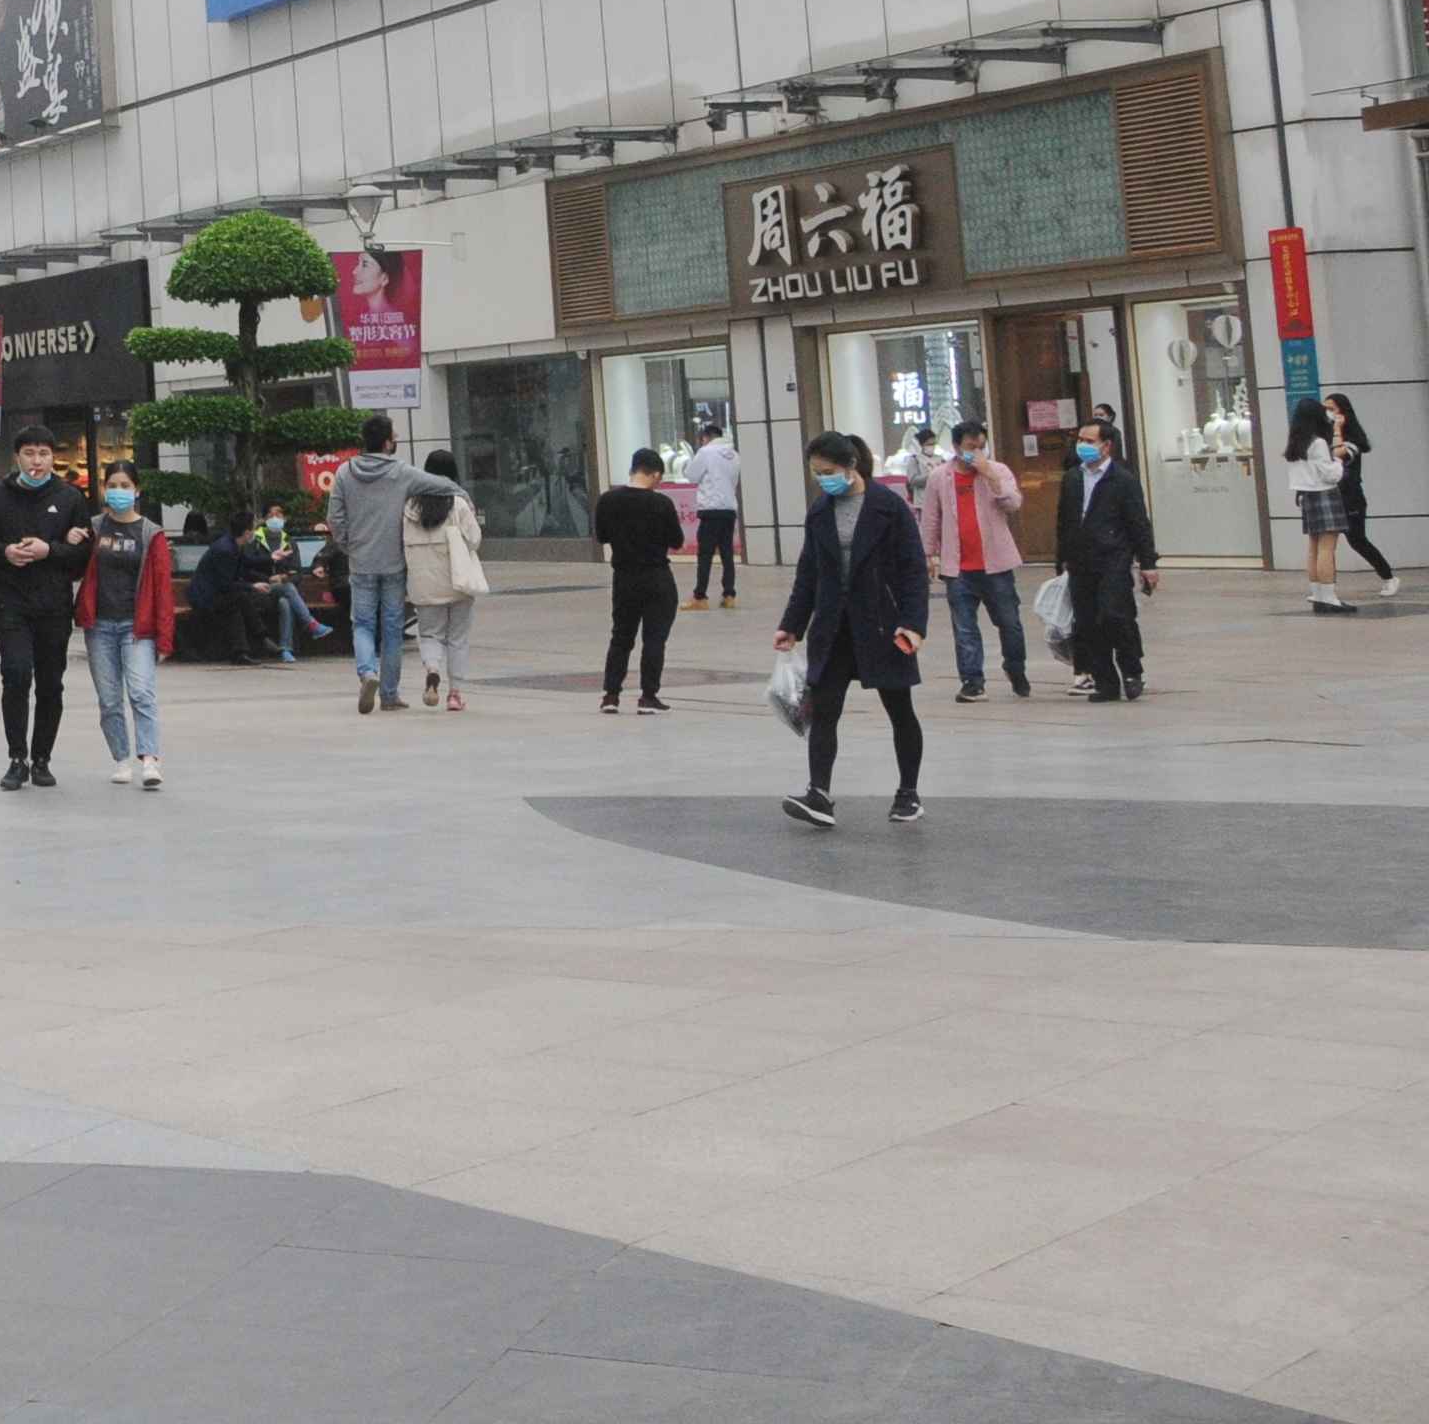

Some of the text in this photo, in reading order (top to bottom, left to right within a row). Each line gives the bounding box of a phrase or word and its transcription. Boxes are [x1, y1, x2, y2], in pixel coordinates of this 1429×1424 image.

[747, 164, 920, 267] 周六福
[749, 259, 918, 303] ZHOU LIU FU
[1, 325, 78, 362] ONVERSE
